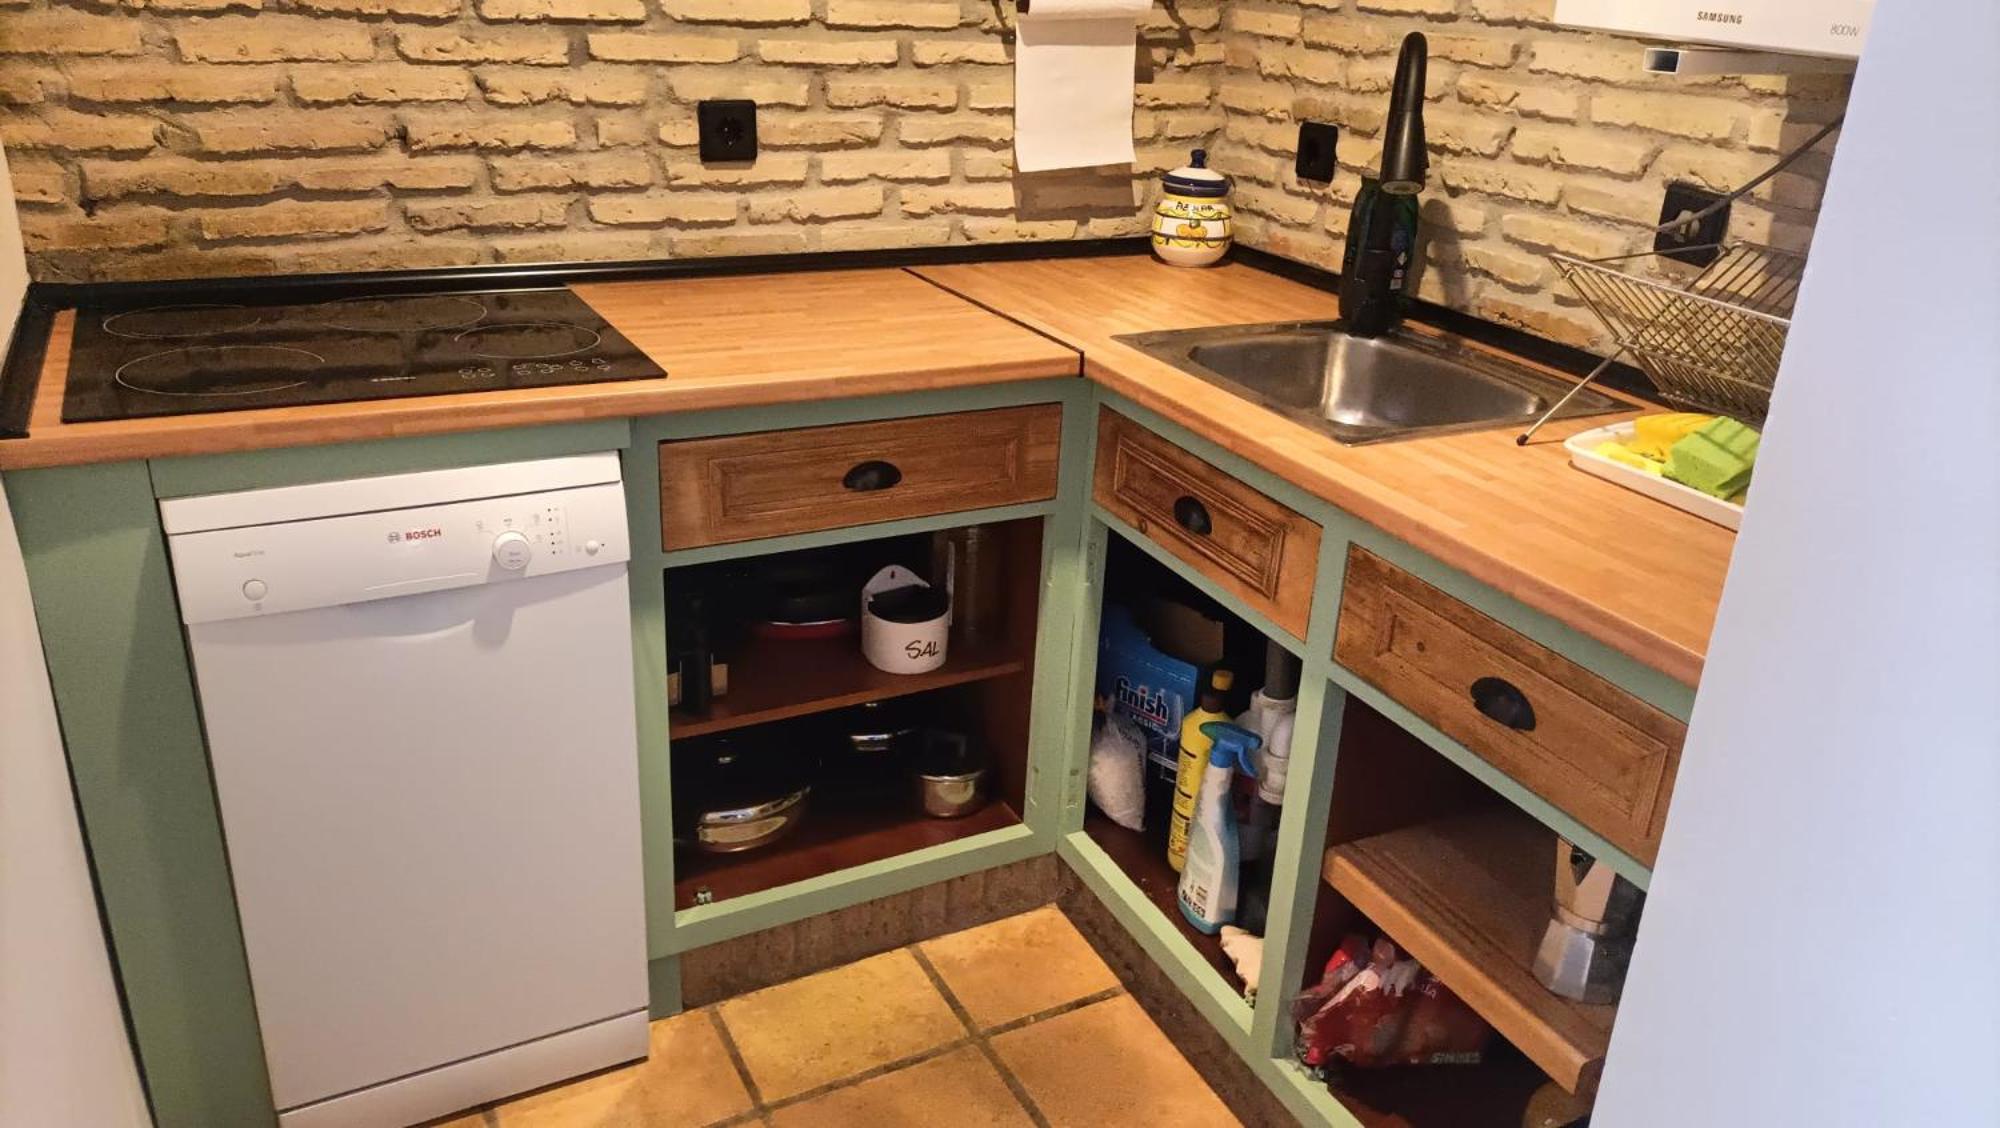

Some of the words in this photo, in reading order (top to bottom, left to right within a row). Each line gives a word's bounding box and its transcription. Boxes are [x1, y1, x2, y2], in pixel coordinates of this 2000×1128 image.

[1696, 10, 1743, 25] SAMSUNG
[1830, 23, 1859, 37] 800W
[405, 528, 442, 541] BOSCH
[904, 640, 939, 659] SAL
[1115, 676, 1169, 720] finish
